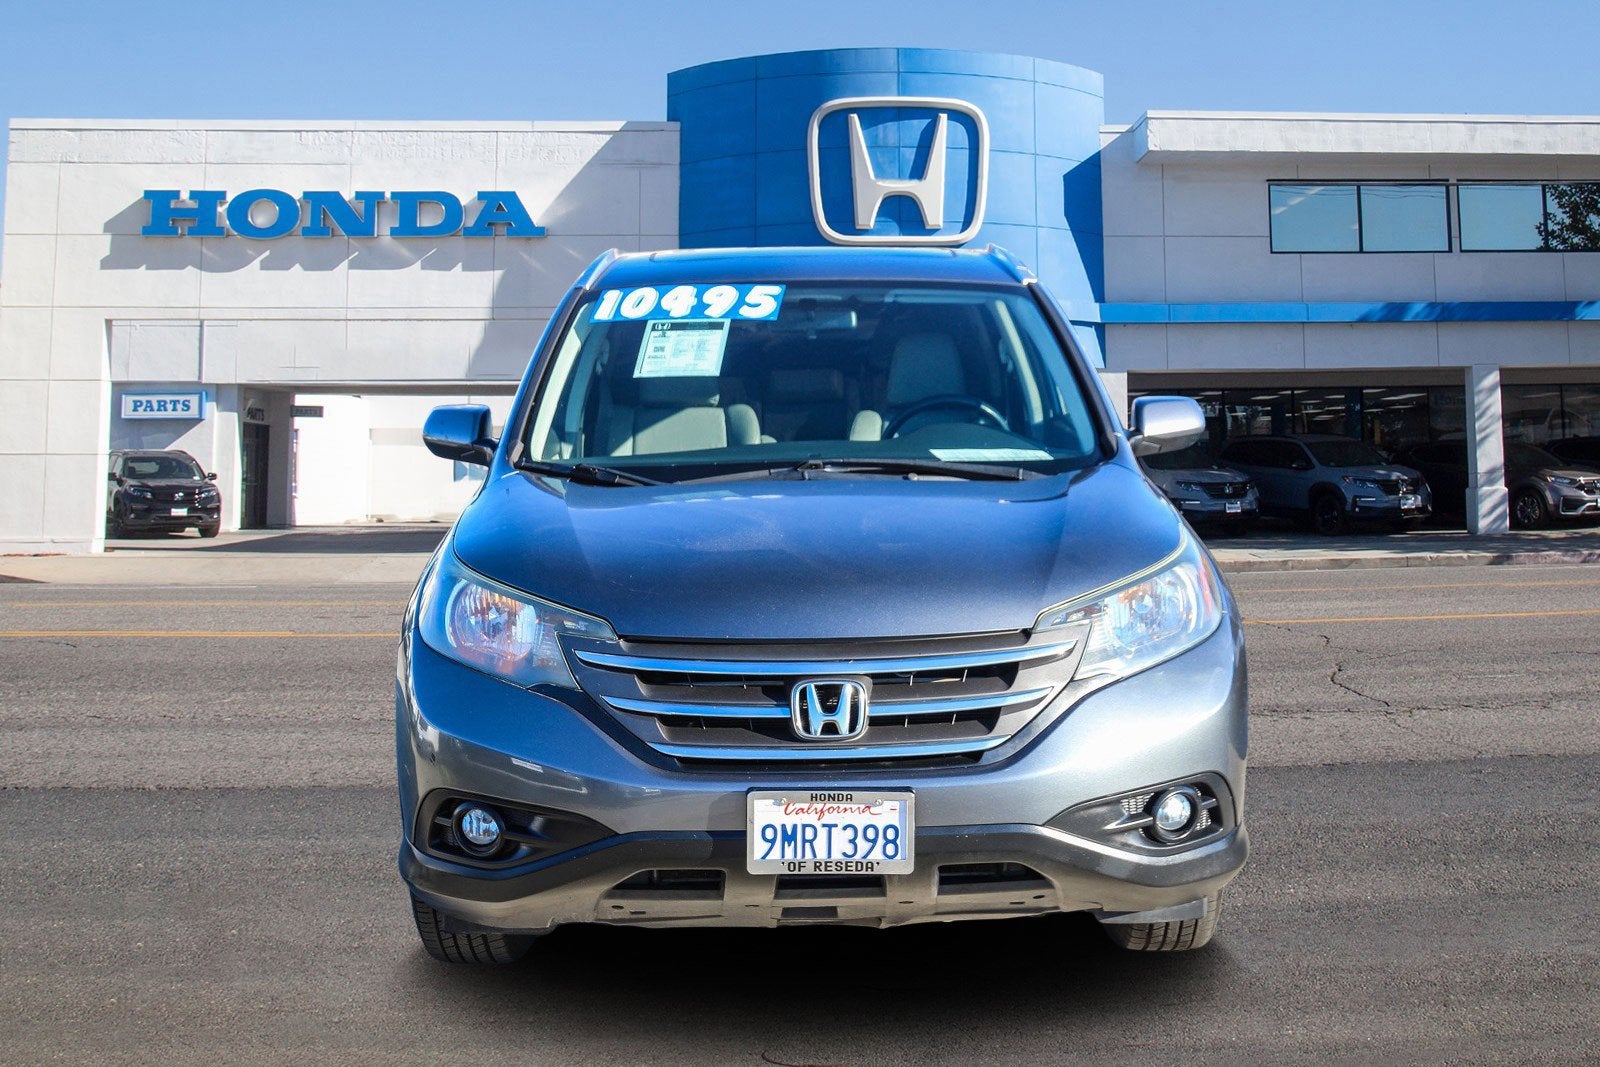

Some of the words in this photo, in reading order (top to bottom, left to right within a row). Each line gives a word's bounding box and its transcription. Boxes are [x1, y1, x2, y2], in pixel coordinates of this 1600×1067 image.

[141, 188, 547, 240] HONDA
[593, 285, 783, 320] 10495
[132, 399, 191, 413] PARTS
[784, 801, 882, 821] California
[810, 793, 853, 802] HONDA
[760, 823, 900, 860] 9MRT398
